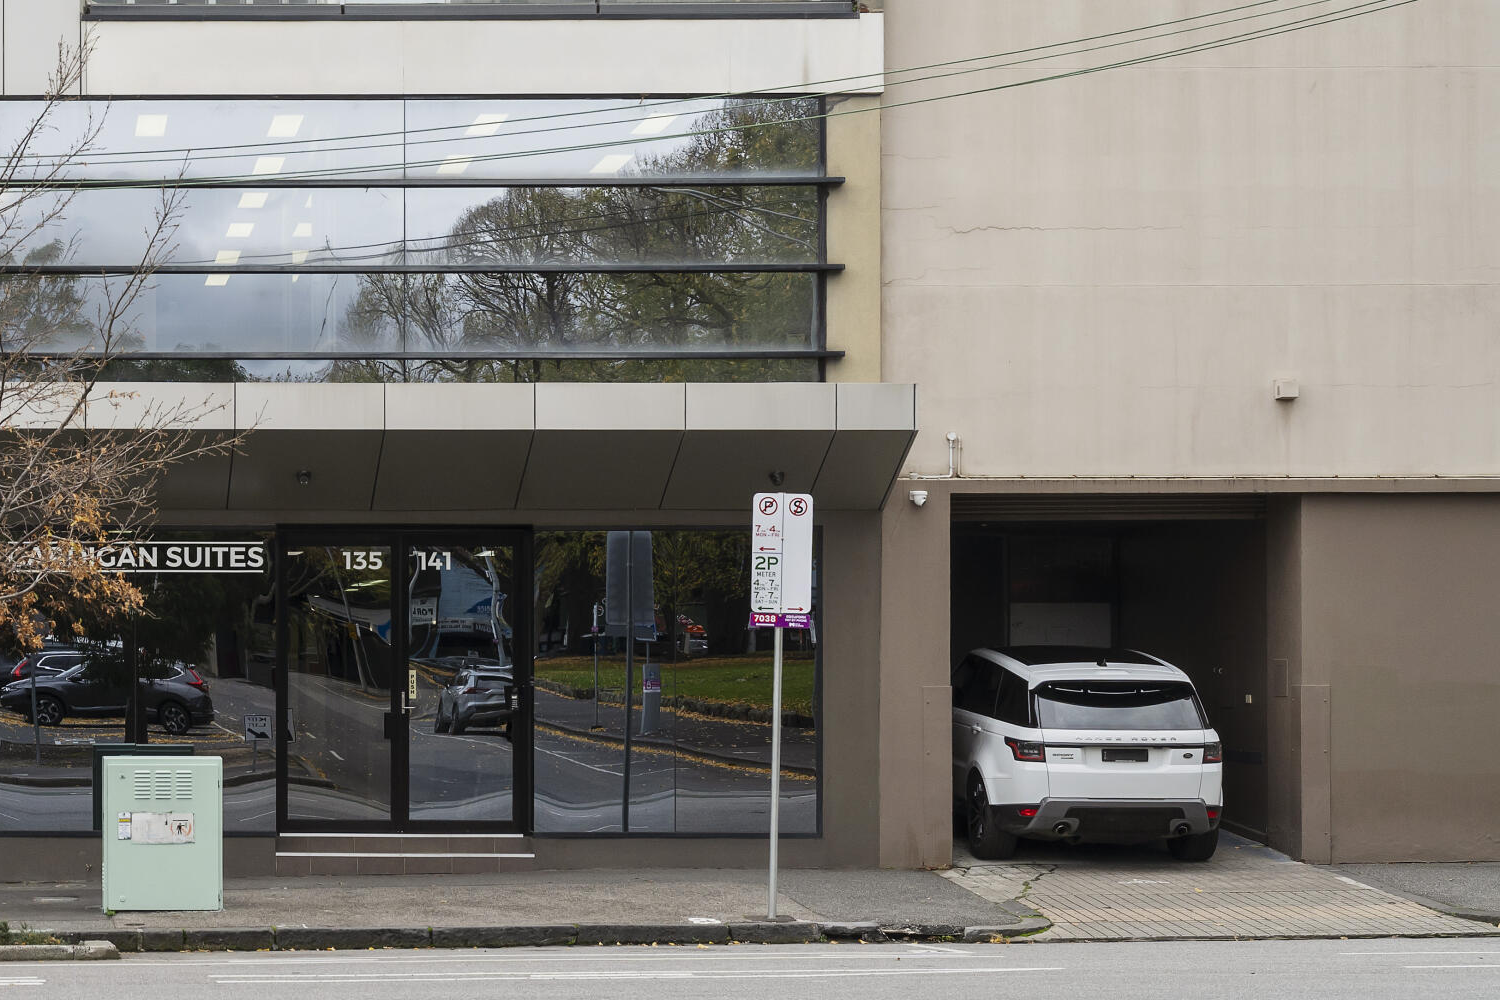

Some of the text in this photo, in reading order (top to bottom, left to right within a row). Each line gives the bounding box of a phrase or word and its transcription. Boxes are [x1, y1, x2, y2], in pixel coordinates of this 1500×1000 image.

[165, 545, 264, 568] SUITES
[342, 551, 383, 571] 135
[418, 551, 452, 571] 141
[754, 556, 779, 570] 2P
[753, 614, 776, 623] 7038
